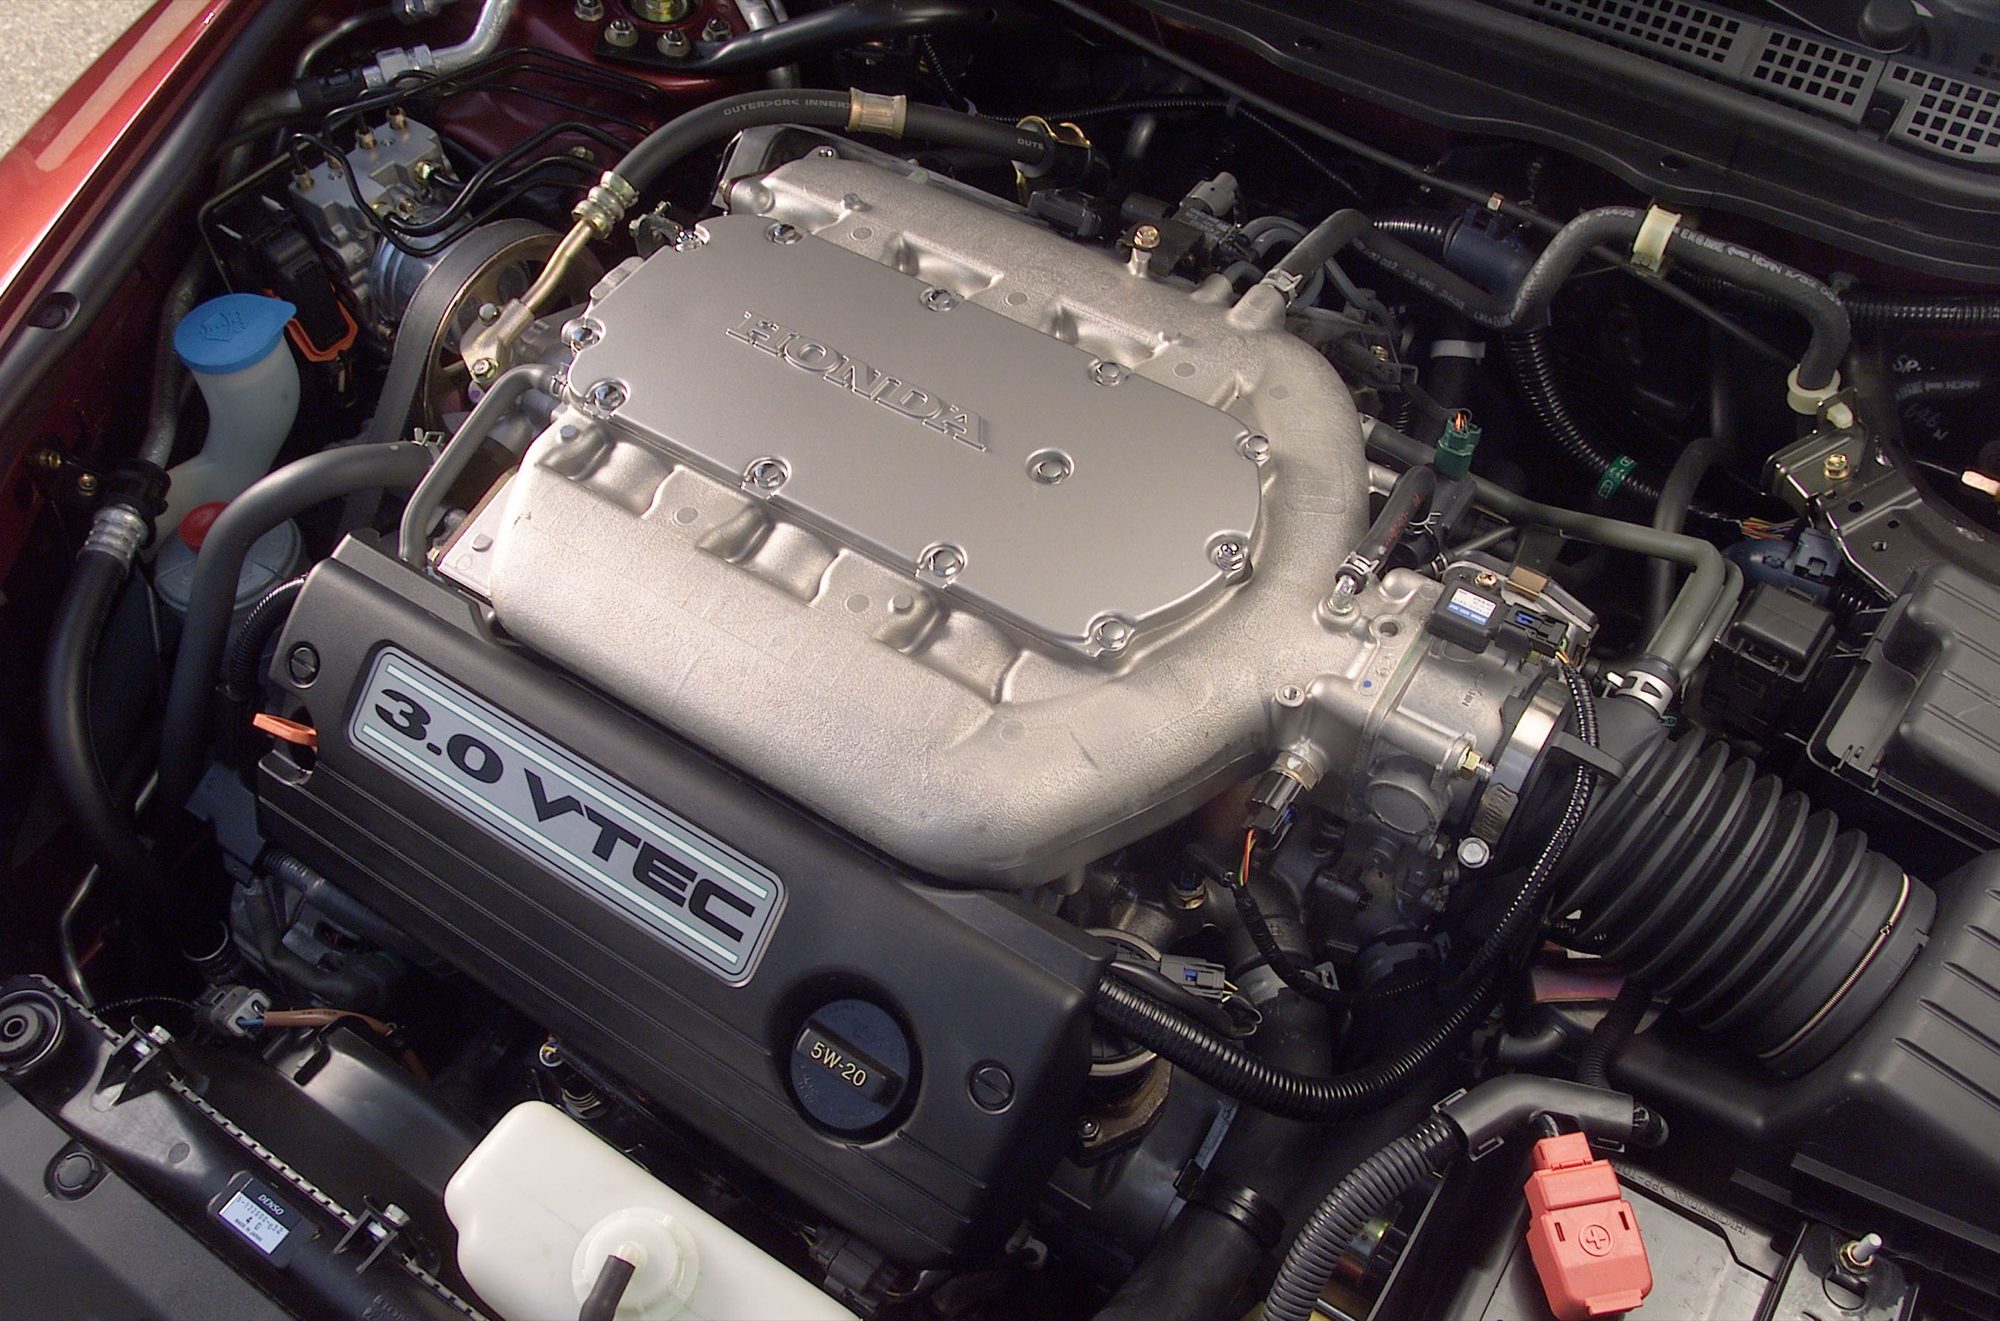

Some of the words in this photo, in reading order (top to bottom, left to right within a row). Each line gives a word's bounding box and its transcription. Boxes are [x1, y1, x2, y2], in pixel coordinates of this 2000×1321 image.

[725, 310, 988, 453] HONDA
[374, 688, 503, 783] 3.0
[522, 769, 754, 943] VTEC
[810, 1040, 868, 1087] 5W-20
[258, 1194, 285, 1216] DENSO
